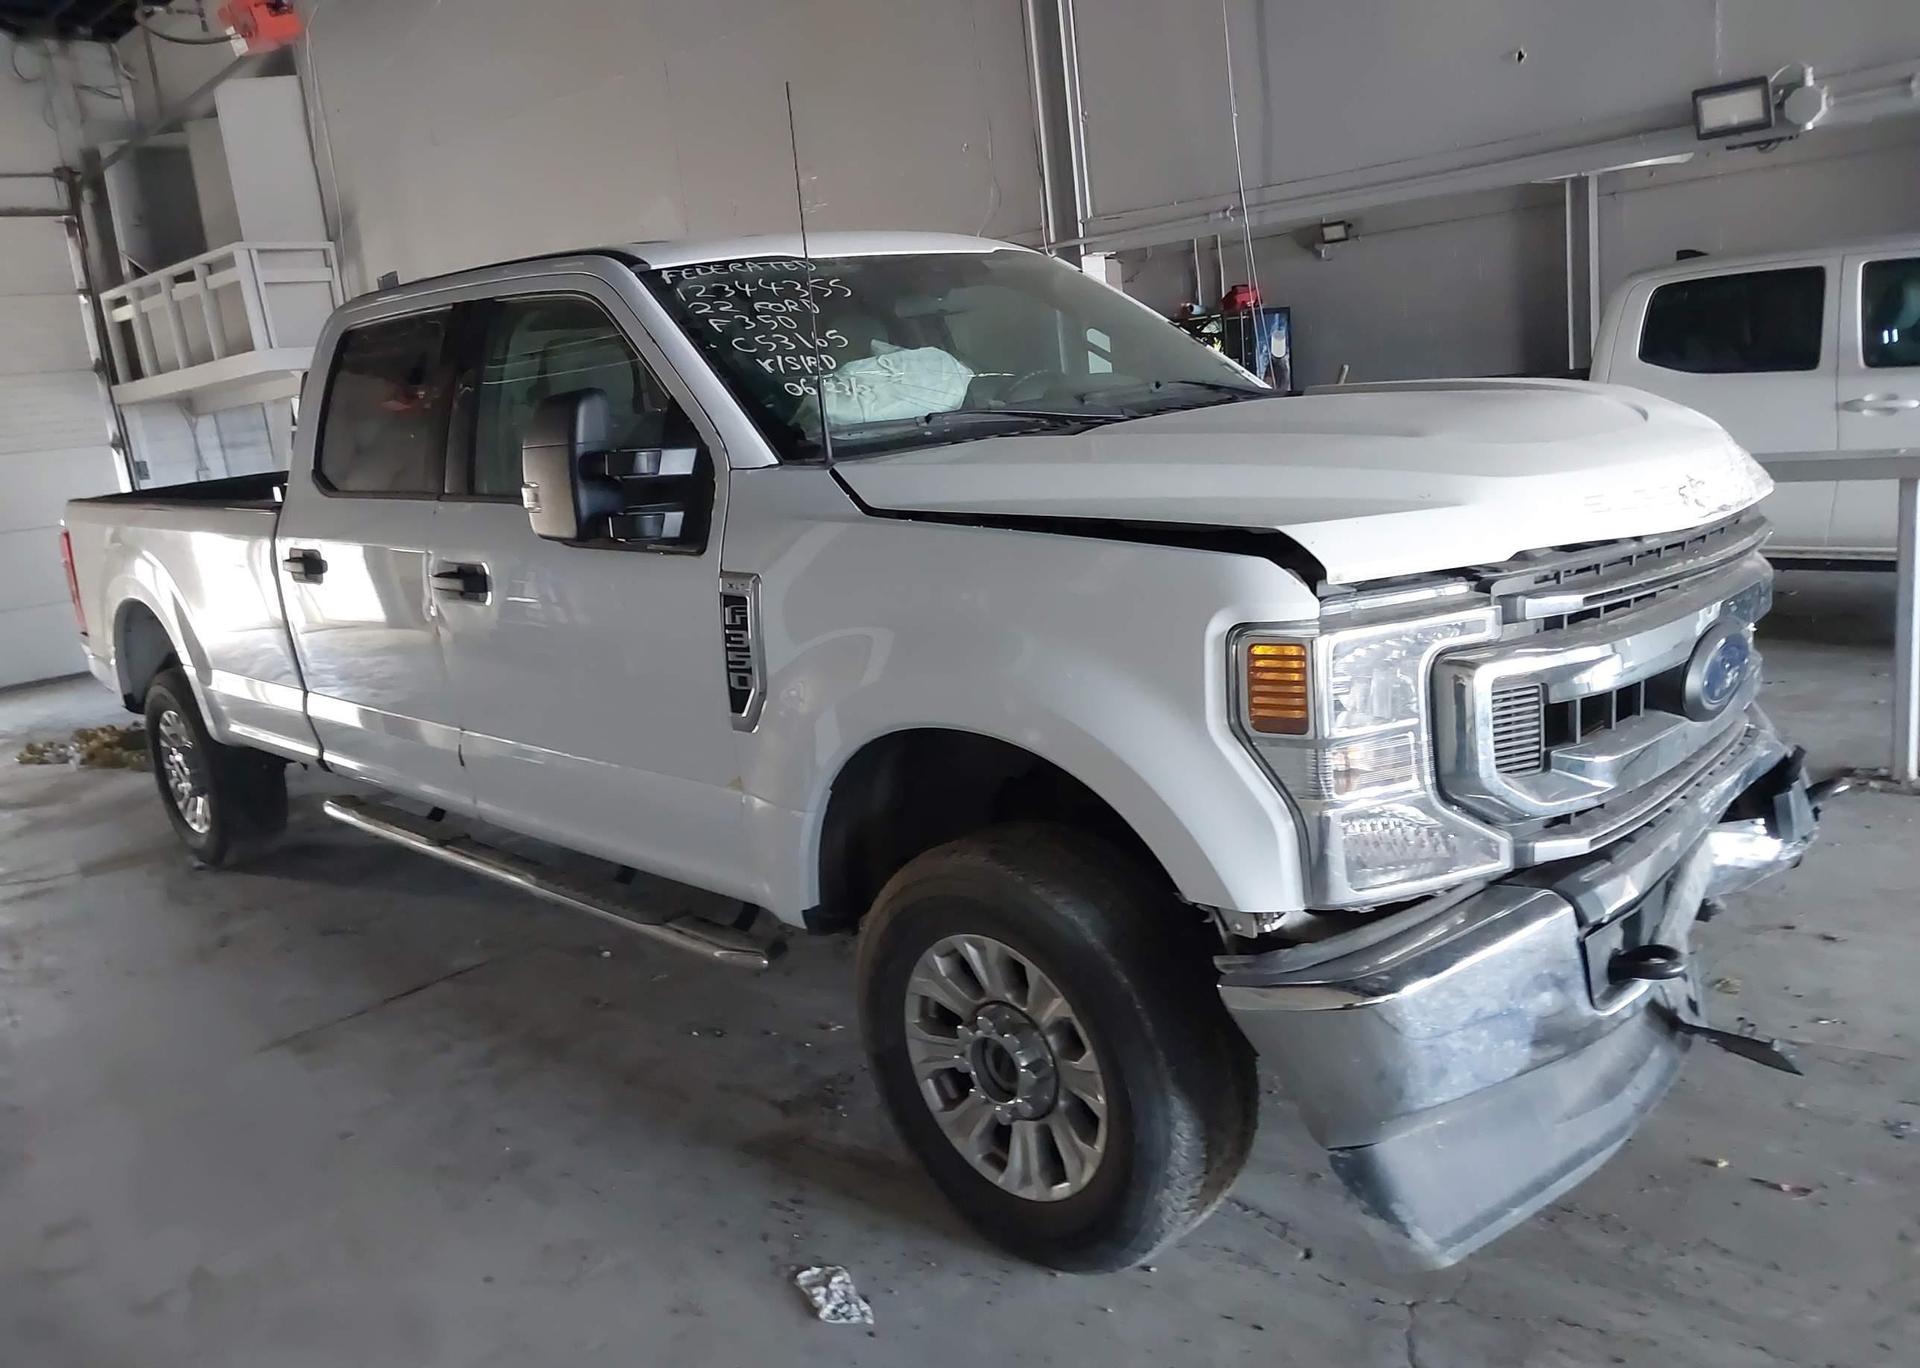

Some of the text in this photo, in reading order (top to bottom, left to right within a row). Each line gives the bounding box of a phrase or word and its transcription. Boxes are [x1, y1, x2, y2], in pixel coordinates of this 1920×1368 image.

[661, 259, 817, 285] FEDERATED
[687, 298, 821, 315] 22 FORD
